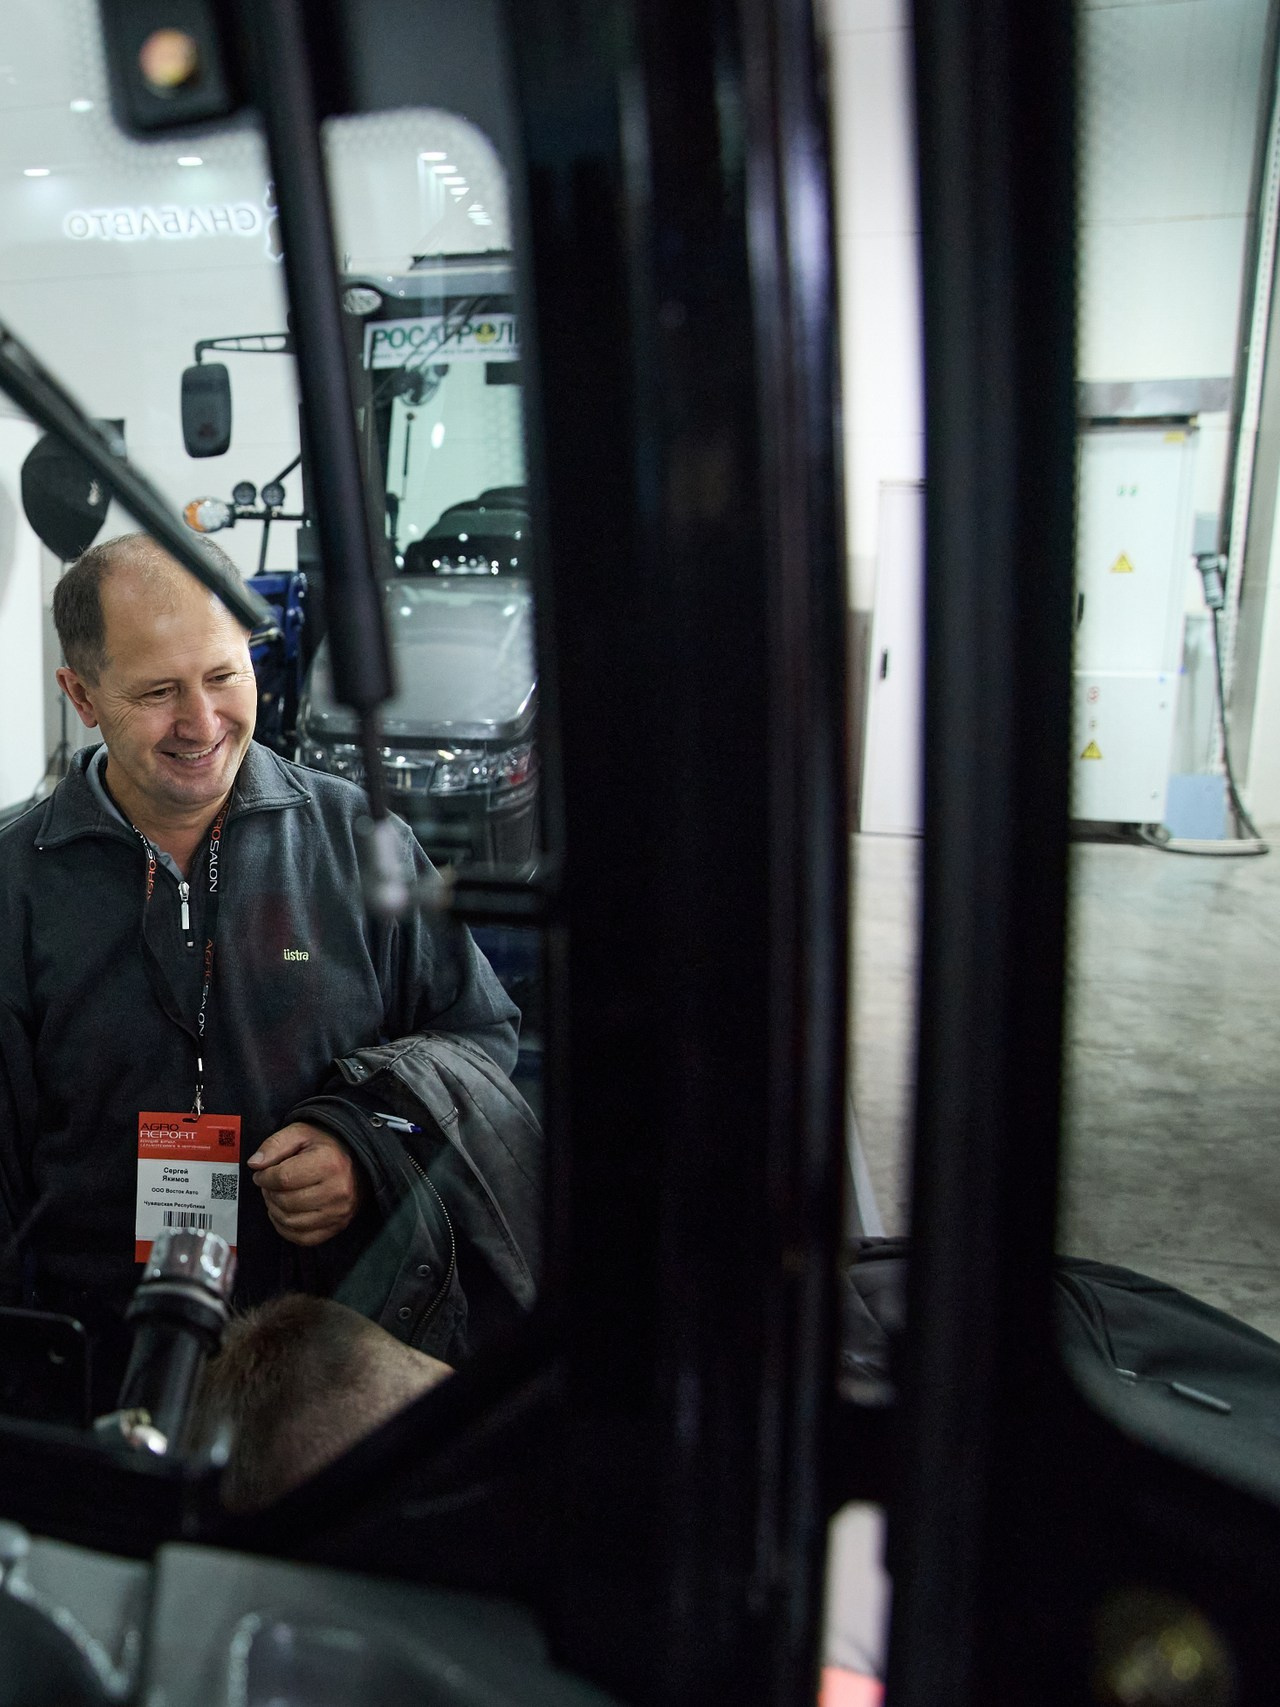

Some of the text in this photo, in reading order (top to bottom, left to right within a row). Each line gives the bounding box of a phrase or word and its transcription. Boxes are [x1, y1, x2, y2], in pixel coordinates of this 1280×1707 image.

[283, 948, 309, 961] üstra
[140, 1123, 180, 1131] AGRO
[140, 1130, 198, 1140] REPORT
[163, 1166, 189, 1176] Сергей
[162, 1175, 190, 1184] Якимов
